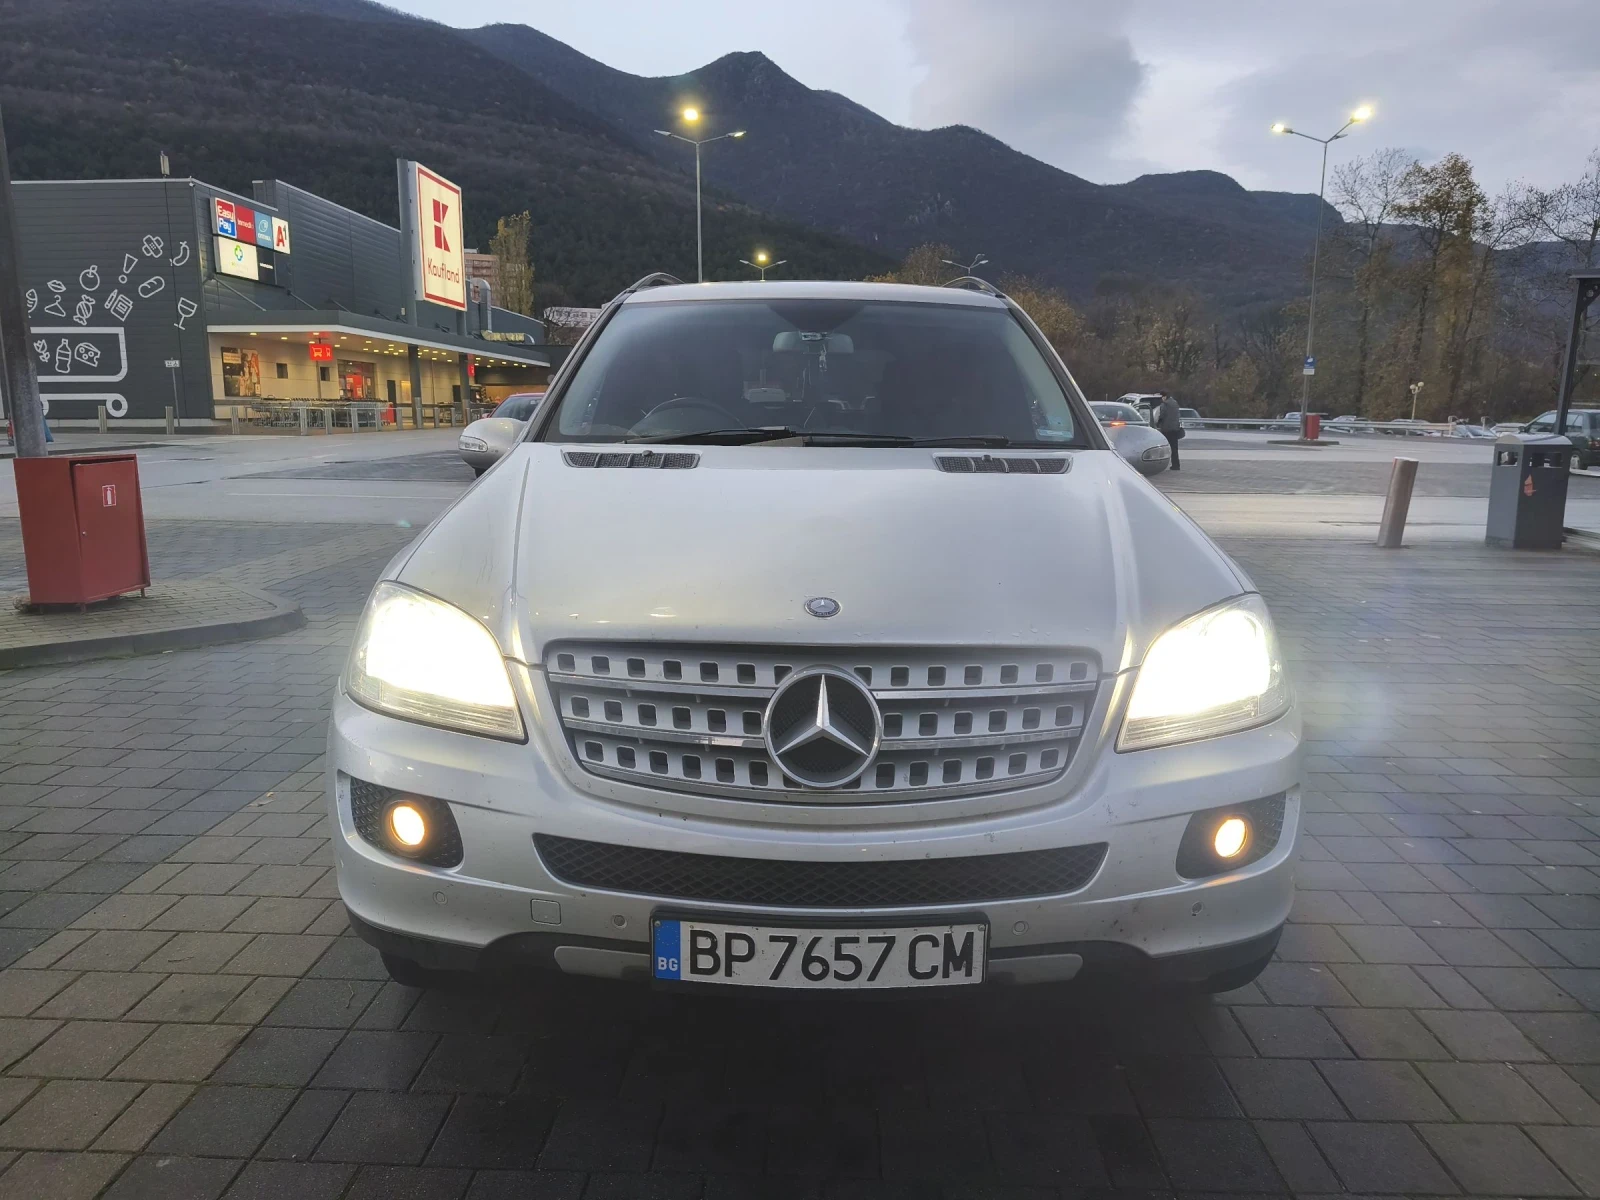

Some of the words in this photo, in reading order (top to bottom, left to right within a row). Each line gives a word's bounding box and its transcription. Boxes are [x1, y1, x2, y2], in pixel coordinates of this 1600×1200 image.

[217, 205, 235, 222] Easy
[218, 219, 232, 233] Pay
[276, 224, 287, 247] A1
[427, 257, 460, 284] Kaufland
[657, 956, 678, 972] BG
[689, 929, 756, 977] BP
[768, 934, 896, 982] 7657
[907, 931, 975, 980] CM
